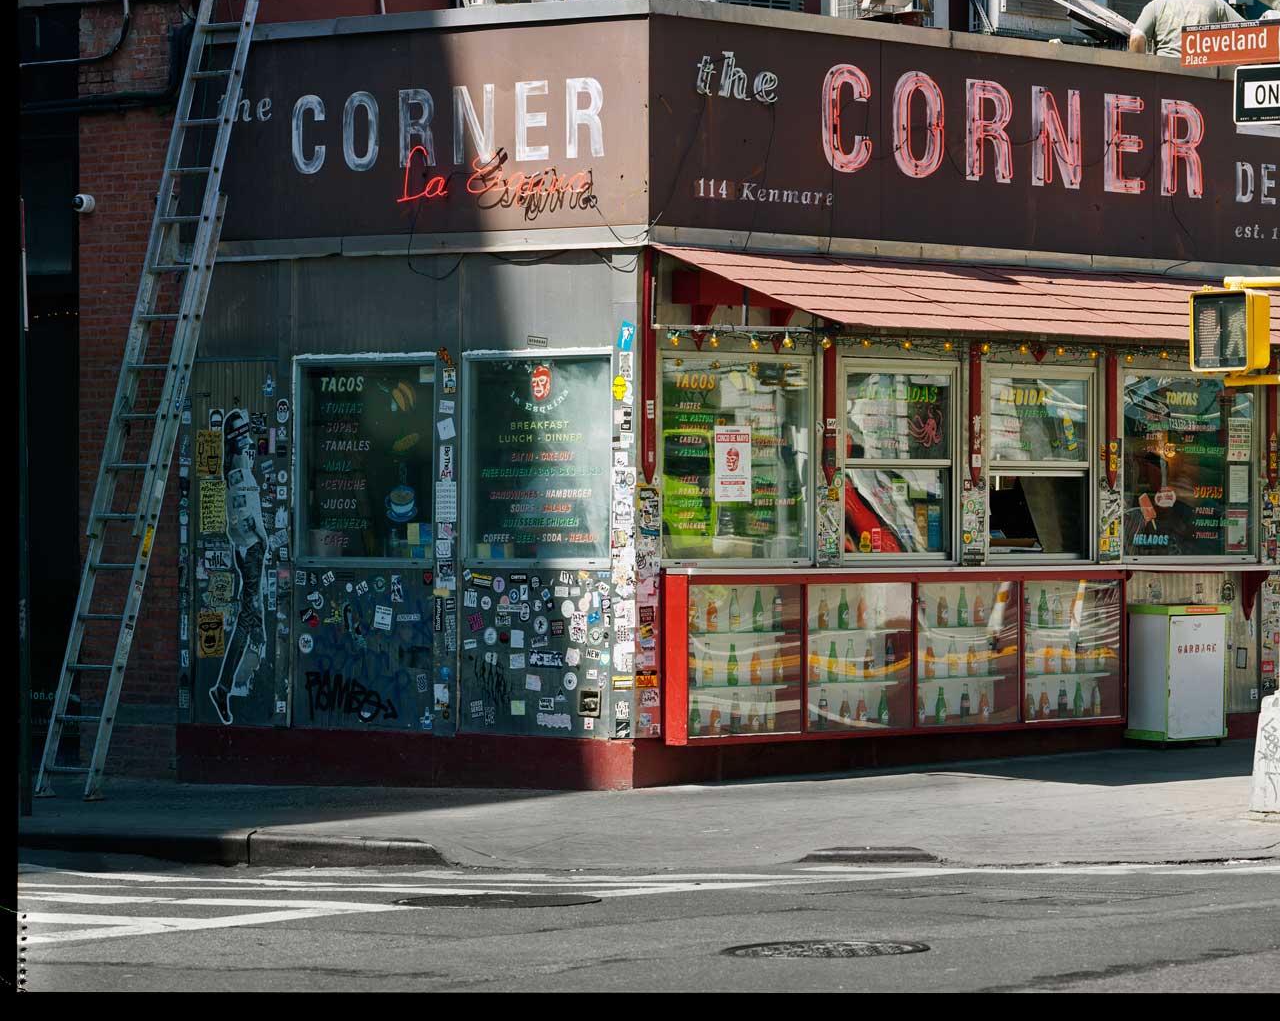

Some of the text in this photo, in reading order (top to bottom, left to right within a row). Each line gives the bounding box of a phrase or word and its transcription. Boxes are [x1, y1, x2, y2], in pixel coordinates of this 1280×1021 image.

[1185, 28, 1267, 55] Cleveland
[1185, 55, 1208, 65] Place
[291, 76, 606, 175] CORNER
[696, 50, 1206, 199] the CORNER
[396, 145, 449, 203] La
[696, 178, 834, 207] 114 Kenmare
[1234, 225, 1265, 239] est.
[320, 376, 365, 393] TACOS
[675, 373, 716, 392] TACOS
[525, 389, 569, 413] Esquina
[1166, 391, 1199, 406] TORTAS
[510, 421, 569, 430] BREAKFAST
[498, 433, 584, 443] LUNCH DINNER
[324, 440, 371, 451] TAMALES
[1192, 484, 1223, 499] SOPAS
[323, 498, 358, 509] JUGOS
[483, 533, 510, 543] COFFEE
[541, 533, 563, 542] SODA
[1132, 533, 1170, 546] HELADOS
[586, 650, 600, 658] NEW
[1177, 642, 1218, 655] GARBAGE
